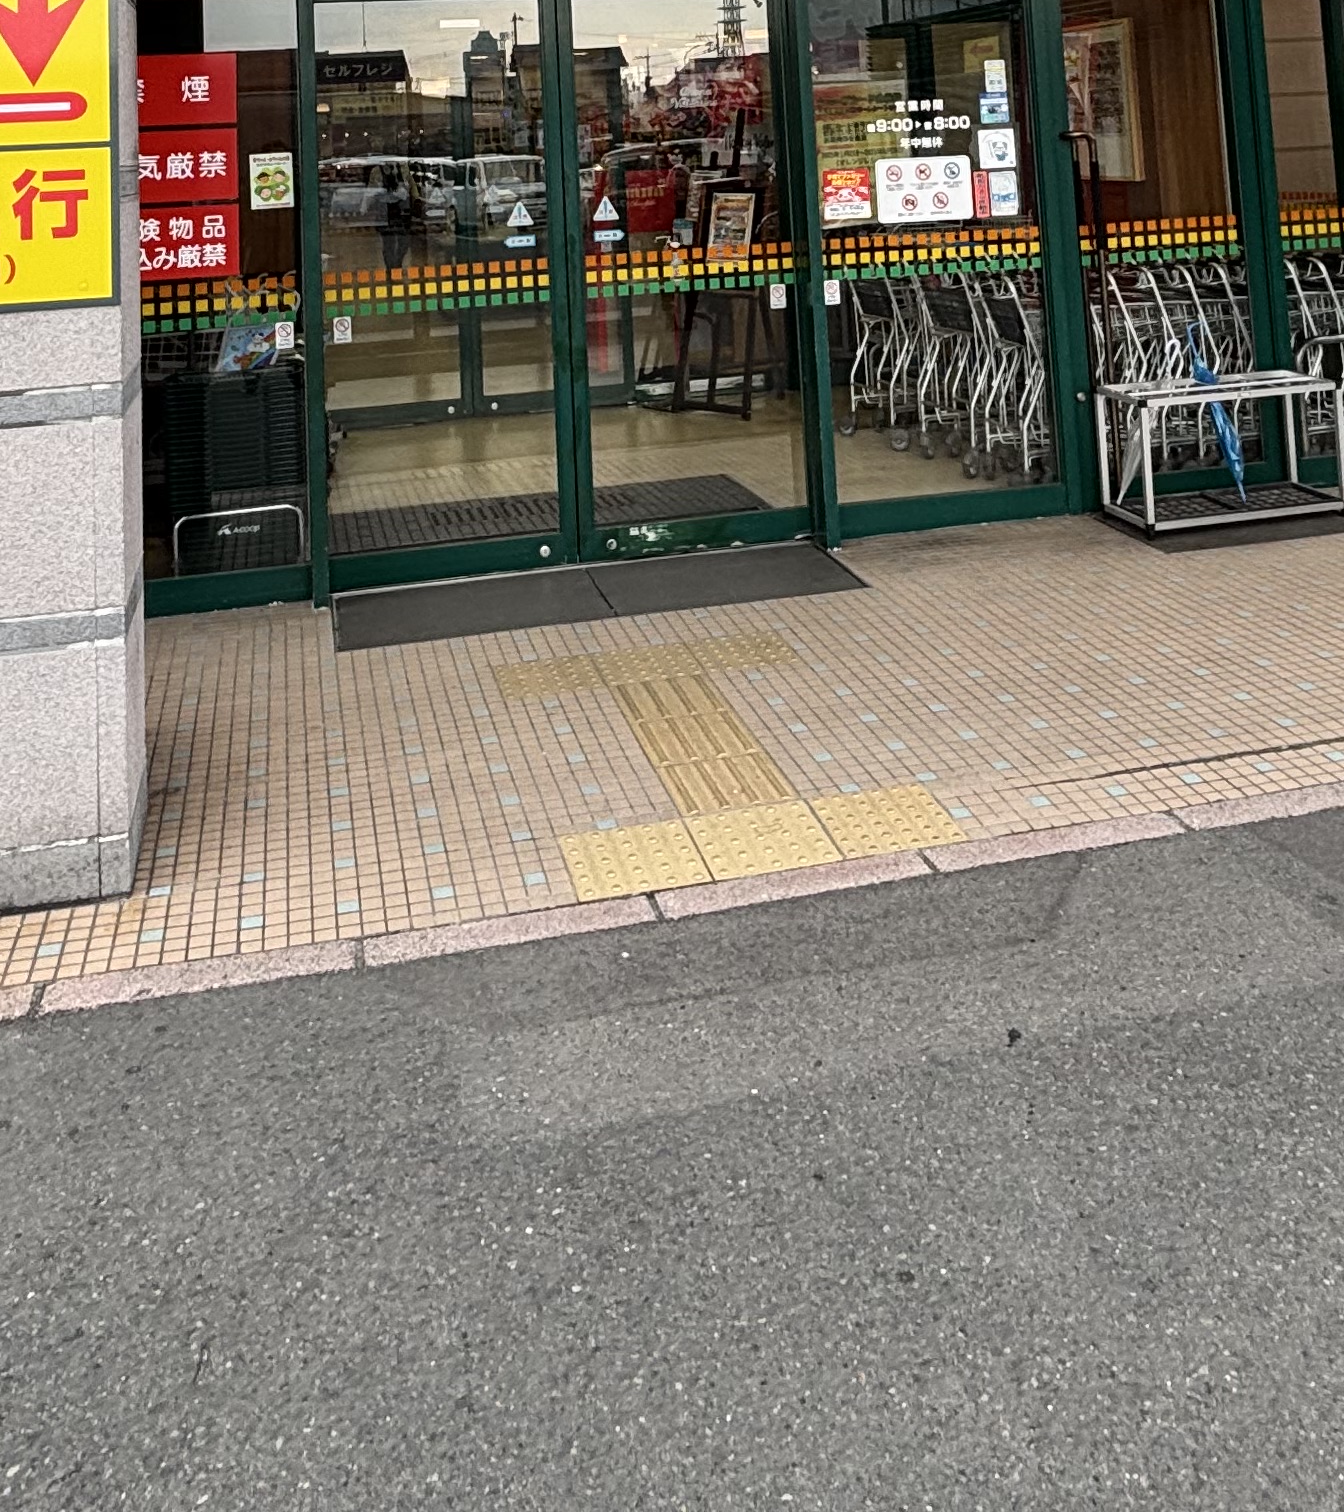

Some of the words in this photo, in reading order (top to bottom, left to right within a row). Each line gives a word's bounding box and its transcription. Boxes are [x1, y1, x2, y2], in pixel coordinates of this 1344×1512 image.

[323, 62, 393, 78] セルフレジ
